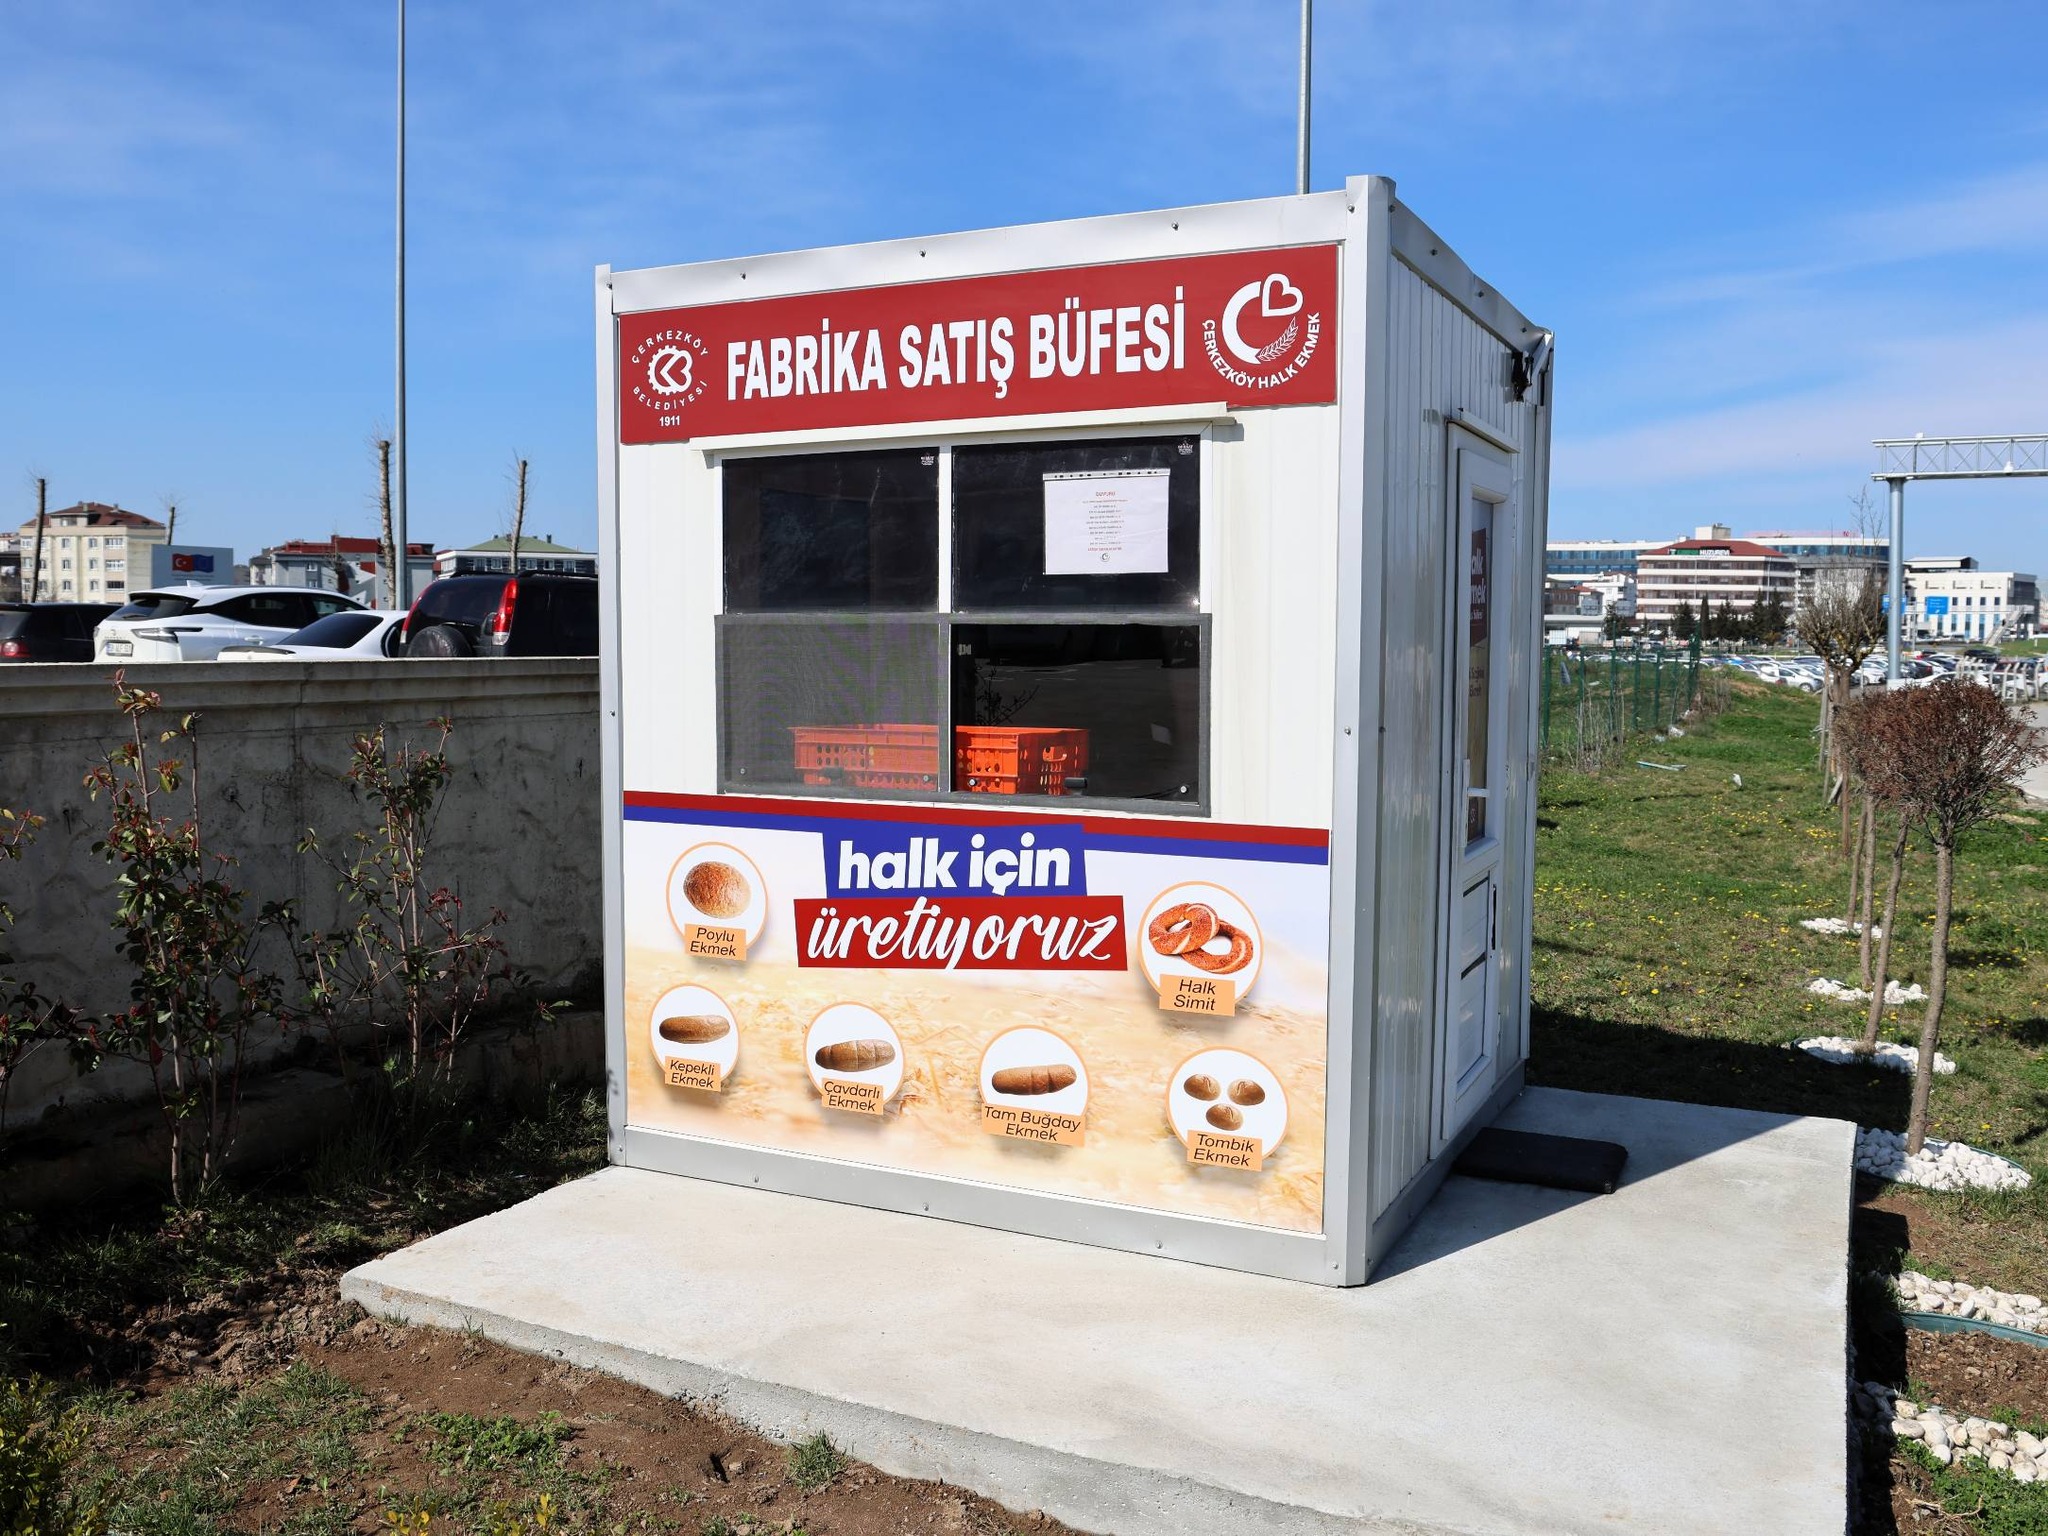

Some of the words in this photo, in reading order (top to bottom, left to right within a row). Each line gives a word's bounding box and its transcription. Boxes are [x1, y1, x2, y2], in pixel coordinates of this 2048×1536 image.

[631, 330, 709, 363] ÇERKEZKÖY
[727, 317, 887, 401] FABRİKA
[899, 316, 1015, 400] SATIŞ
[1029, 285, 1185, 380] BÜFESİ
[1202, 319, 1256, 388] ÇERKEZKÖY
[1258, 363, 1299, 389] HALK
[1294, 312, 1320, 368] EKMEK
[659, 415, 681, 427] 1911
[838, 836, 959, 890] halk
[968, 832, 1071, 896] için
[696, 927, 735, 943] Poylu
[807, 896, 1118, 970] üretiyoruz
[689, 940, 737, 957] Ekmek
[1179, 979, 1216, 995] Halk
[1173, 994, 1216, 1011] Simit
[669, 1059, 715, 1078] Kepekli
[671, 1072, 714, 1089] Ekmek
[823, 1080, 880, 1100] Çavdarlı
[828, 1095, 876, 1112] Ekmek
[984, 1105, 1017, 1122] Tam
[1020, 1110, 1081, 1133] Buğday
[1005, 1123, 1058, 1142] Ekmek
[1197, 1133, 1254, 1153] Tombik
[1193, 1148, 1250, 1167] Ekmek
